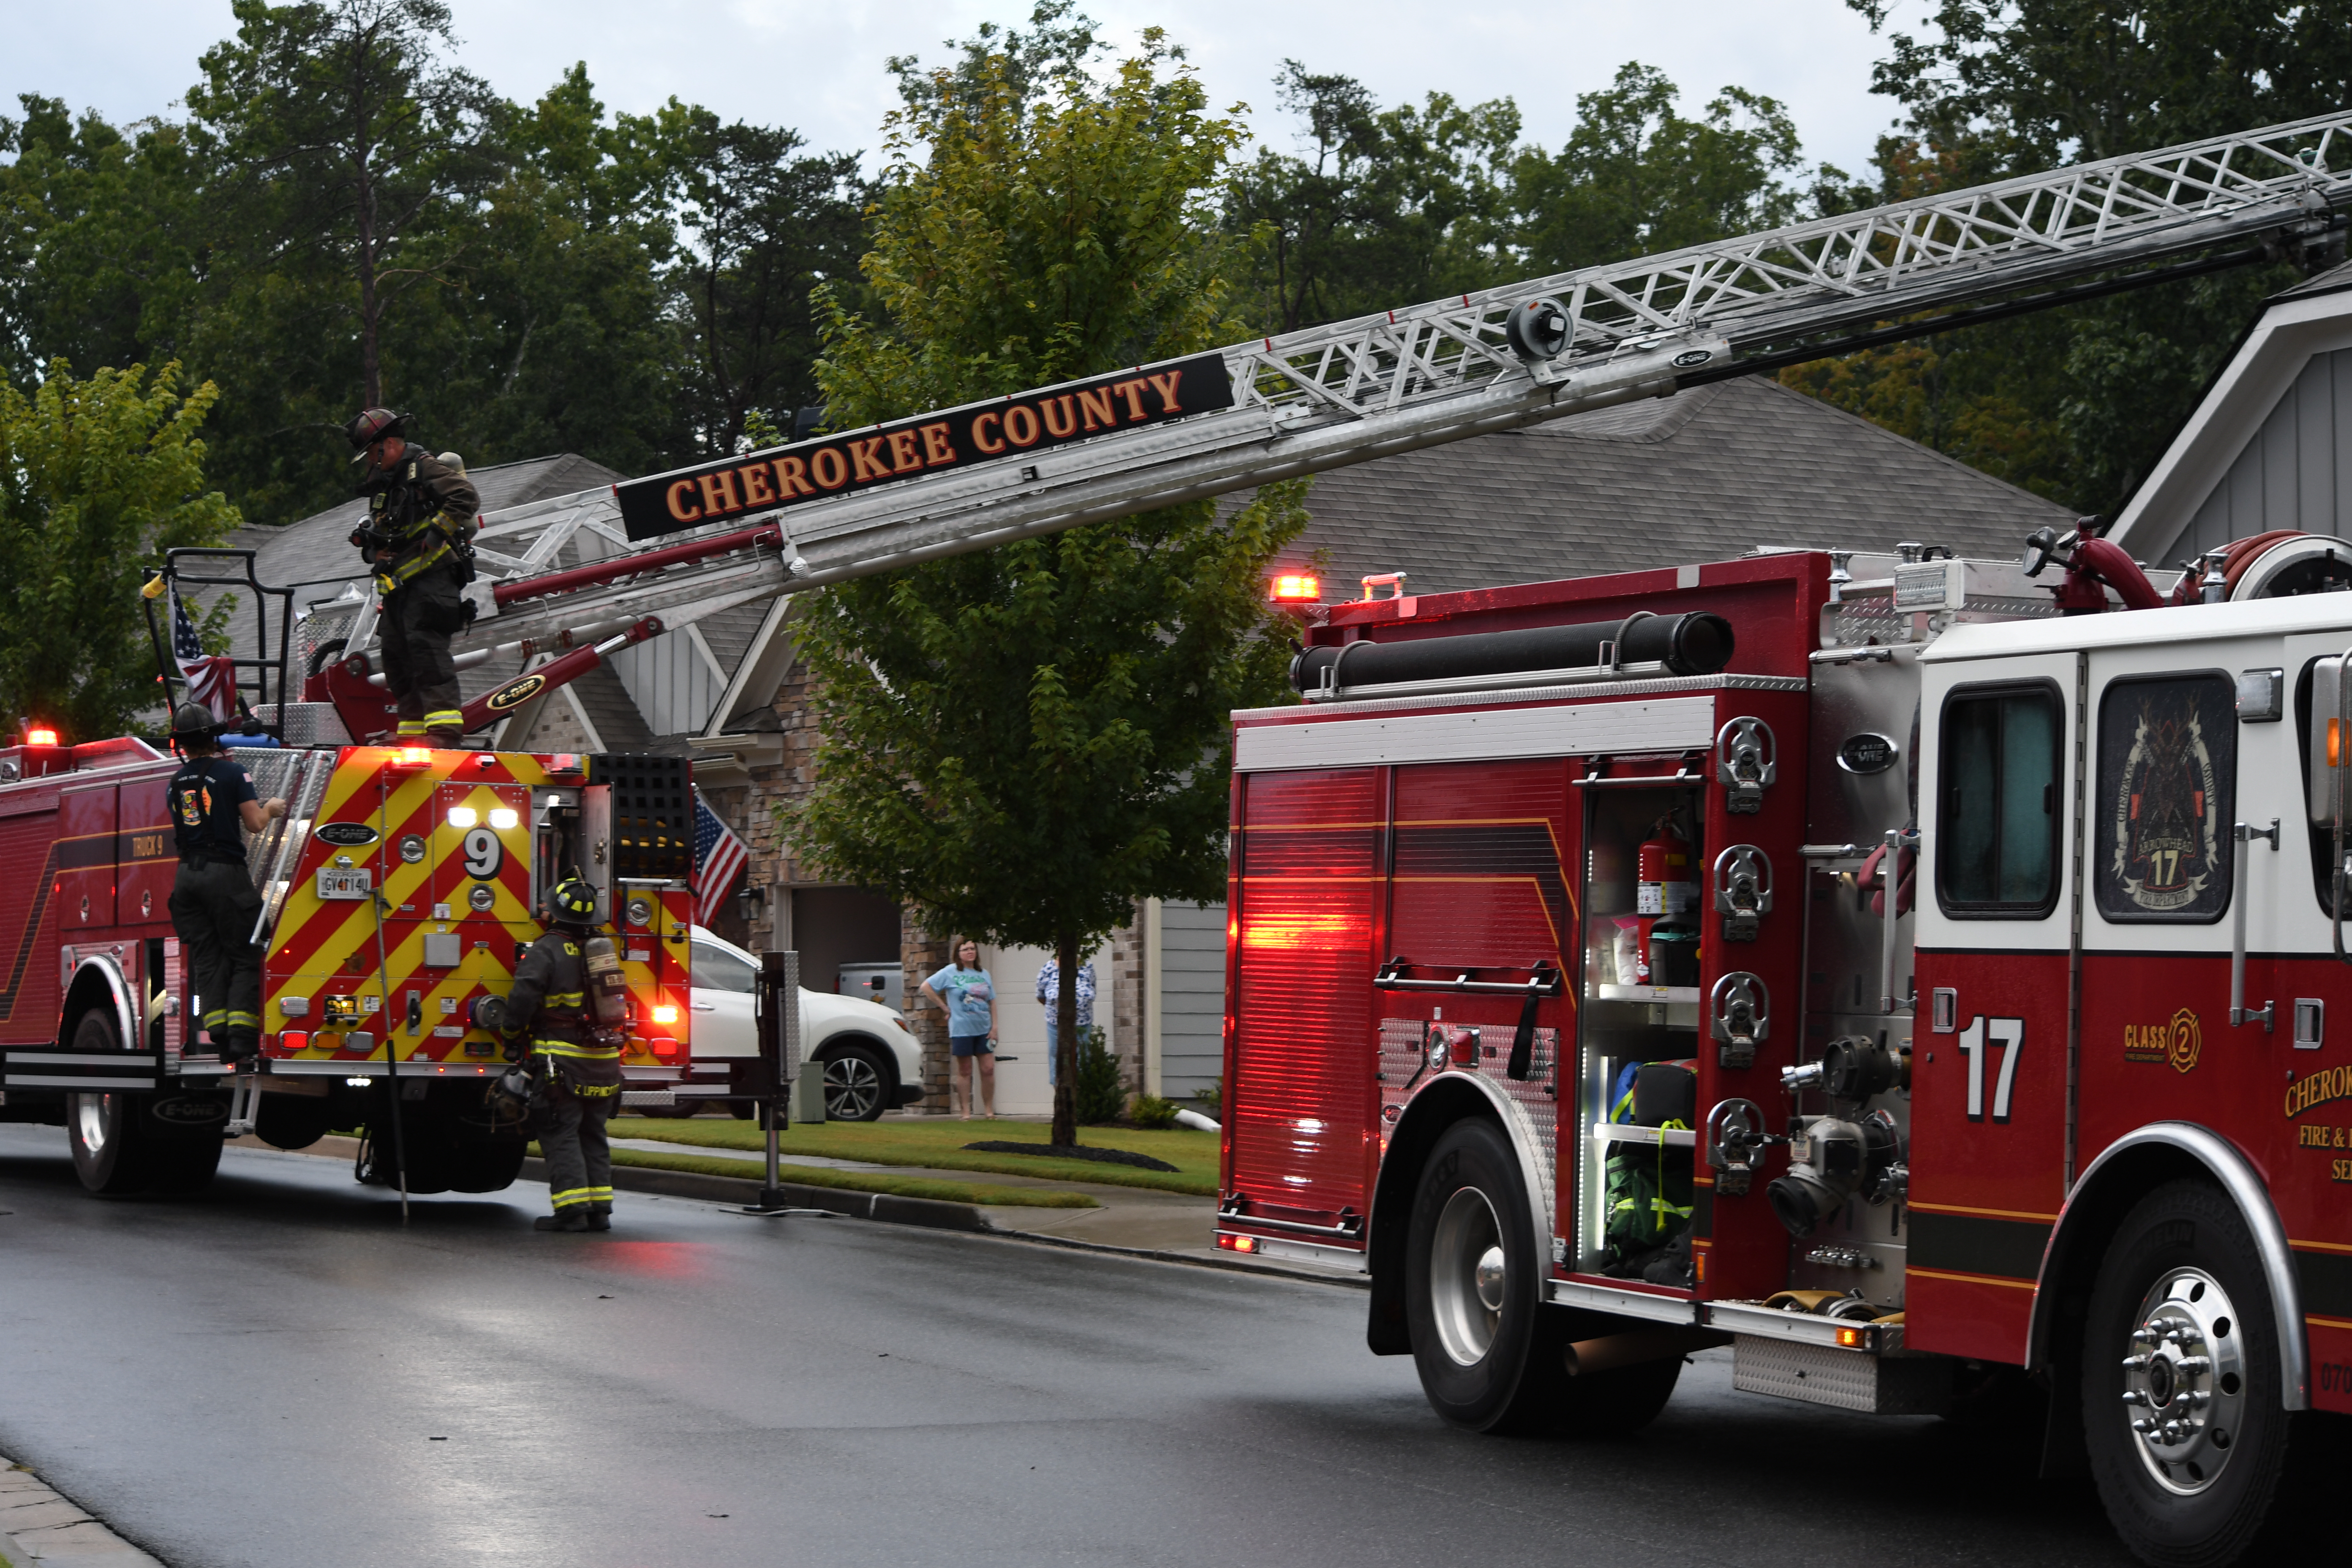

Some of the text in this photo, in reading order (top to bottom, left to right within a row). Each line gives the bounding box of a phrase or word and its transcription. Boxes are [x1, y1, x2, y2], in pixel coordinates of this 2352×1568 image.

[1678, 352, 1707, 364] E-ONE
[667, 370, 1182, 523] CHEROKEE COUNTY
[497, 679, 536, 705] E-ONE
[1847, 743, 1885, 762] E-ONE
[326, 828, 369, 839] E-ONE
[132, 835, 163, 857] TRUCK 9
[464, 828, 501, 879] 9
[2138, 837, 2194, 855] ARROWHEAD
[2151, 849, 2179, 885] 17
[2124, 1024, 2189, 1053] CLASS 2
[1959, 1016, 2023, 1119] 17
[165, 1103, 215, 1116] E-ONE
[2299, 1125, 2330, 1146] FIRE
[2333, 1127, 2345, 1148] &
